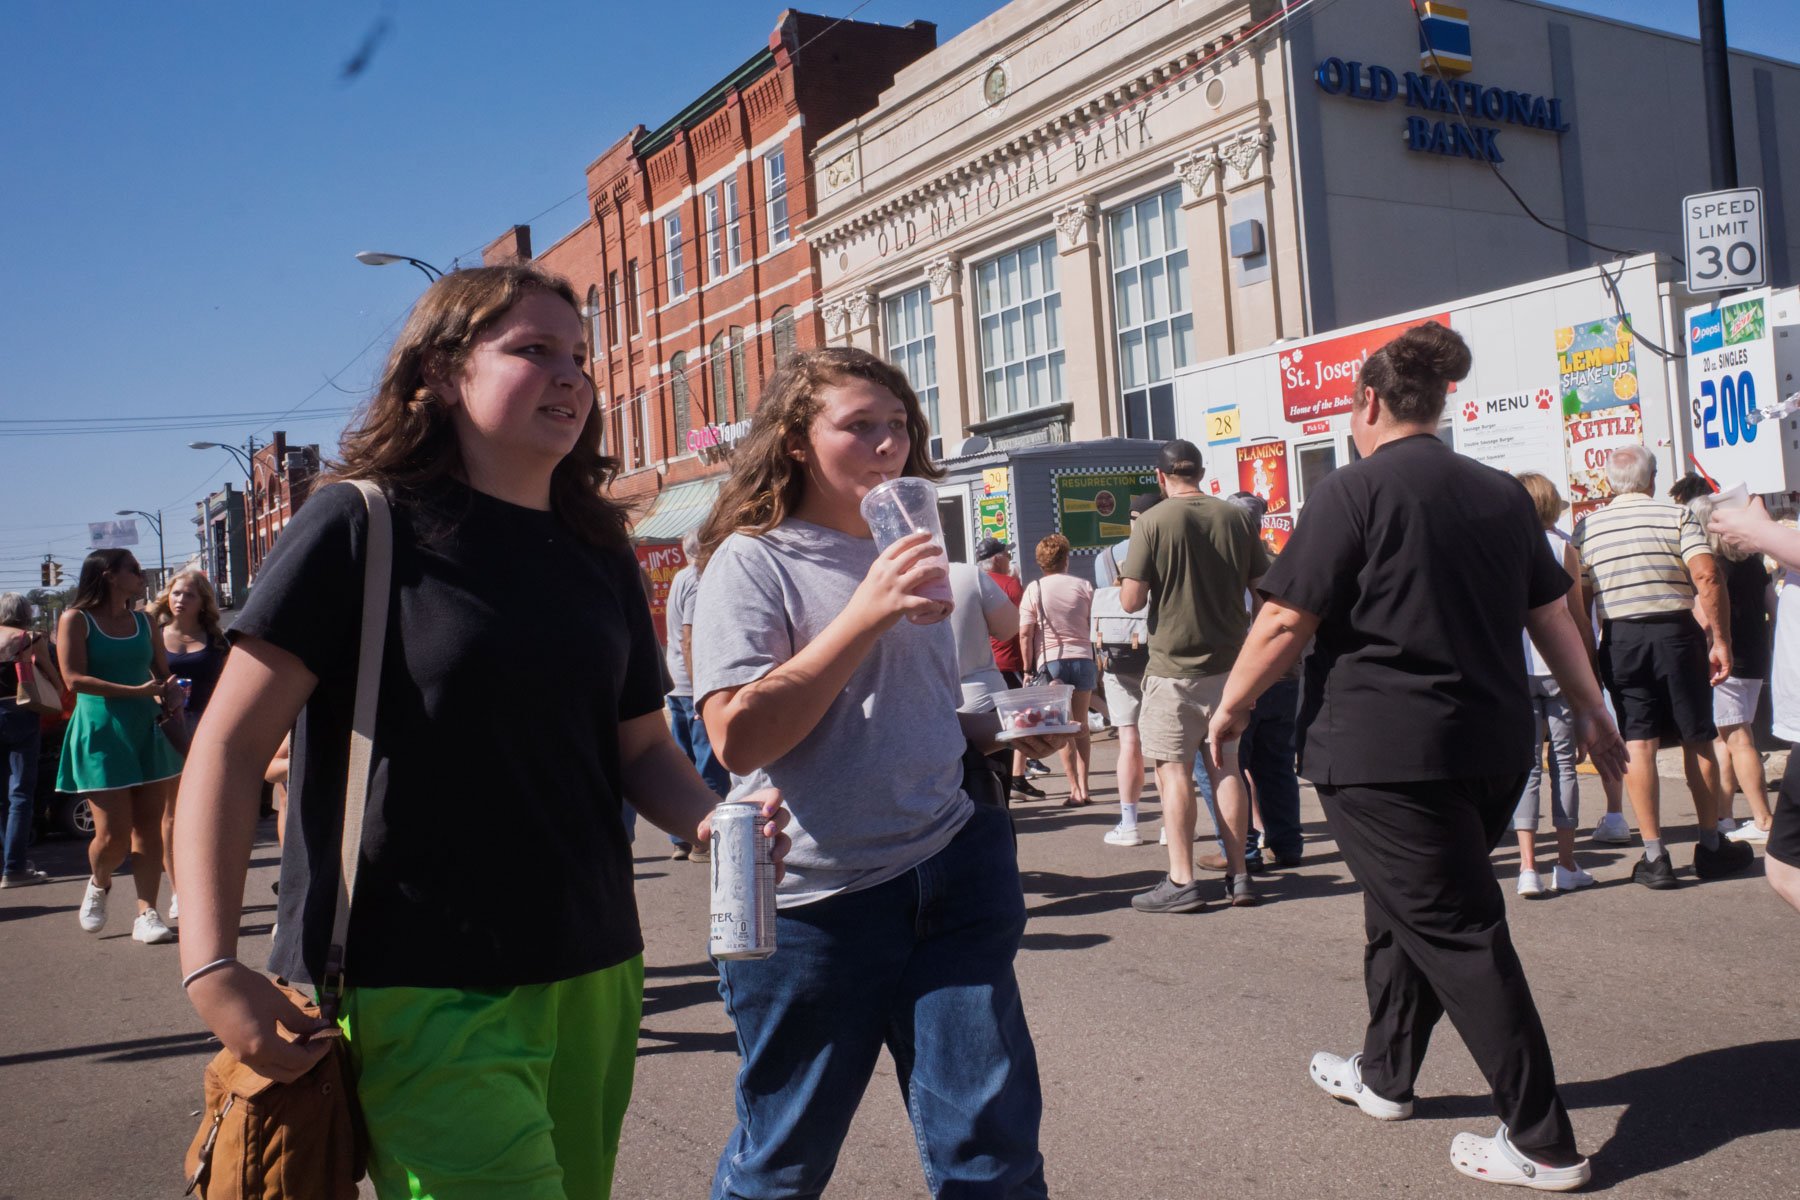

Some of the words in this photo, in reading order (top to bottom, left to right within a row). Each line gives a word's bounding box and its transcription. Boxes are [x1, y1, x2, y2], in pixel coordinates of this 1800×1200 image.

[1317, 57, 1399, 101] OLD
[1403, 71, 1571, 133] NATIONAL
[1407, 115, 1504, 163] BANK
[877, 220, 917, 257] OLD
[931, 156, 1058, 238] NATIONAL
[1074, 108, 1153, 172] BANK
[1692, 199, 1756, 220] SPEED
[1699, 220, 1749, 240] LIMIT
[1696, 241, 1757, 280] 30
[1701, 321, 1721, 338] pepsi
[1558, 340, 1631, 375] LEMON
[1703, 356, 1711, 372] 20
[1718, 348, 1748, 369] SINGLES
[1286, 367, 1311, 389] St.
[1562, 362, 1629, 389] SHAKE-UP
[1290, 404, 1311, 416] Home
[1312, 402, 1322, 415] of
[1321, 399, 1333, 410] the
[1334, 395, 1355, 408] Bobc
[1486, 394, 1529, 414] MENU
[1214, 415, 1232, 436] 28
[1317, 422, 1326, 432] Up
[1568, 416, 1636, 444] KETTLE
[1237, 443, 1284, 463] FLAMING
[1062, 476, 1136, 488] RESURRECTION
[1139, 475, 1158, 485] CHU
[1265, 497, 1287, 515] ILER
[1261, 517, 1291, 532] SAGE
